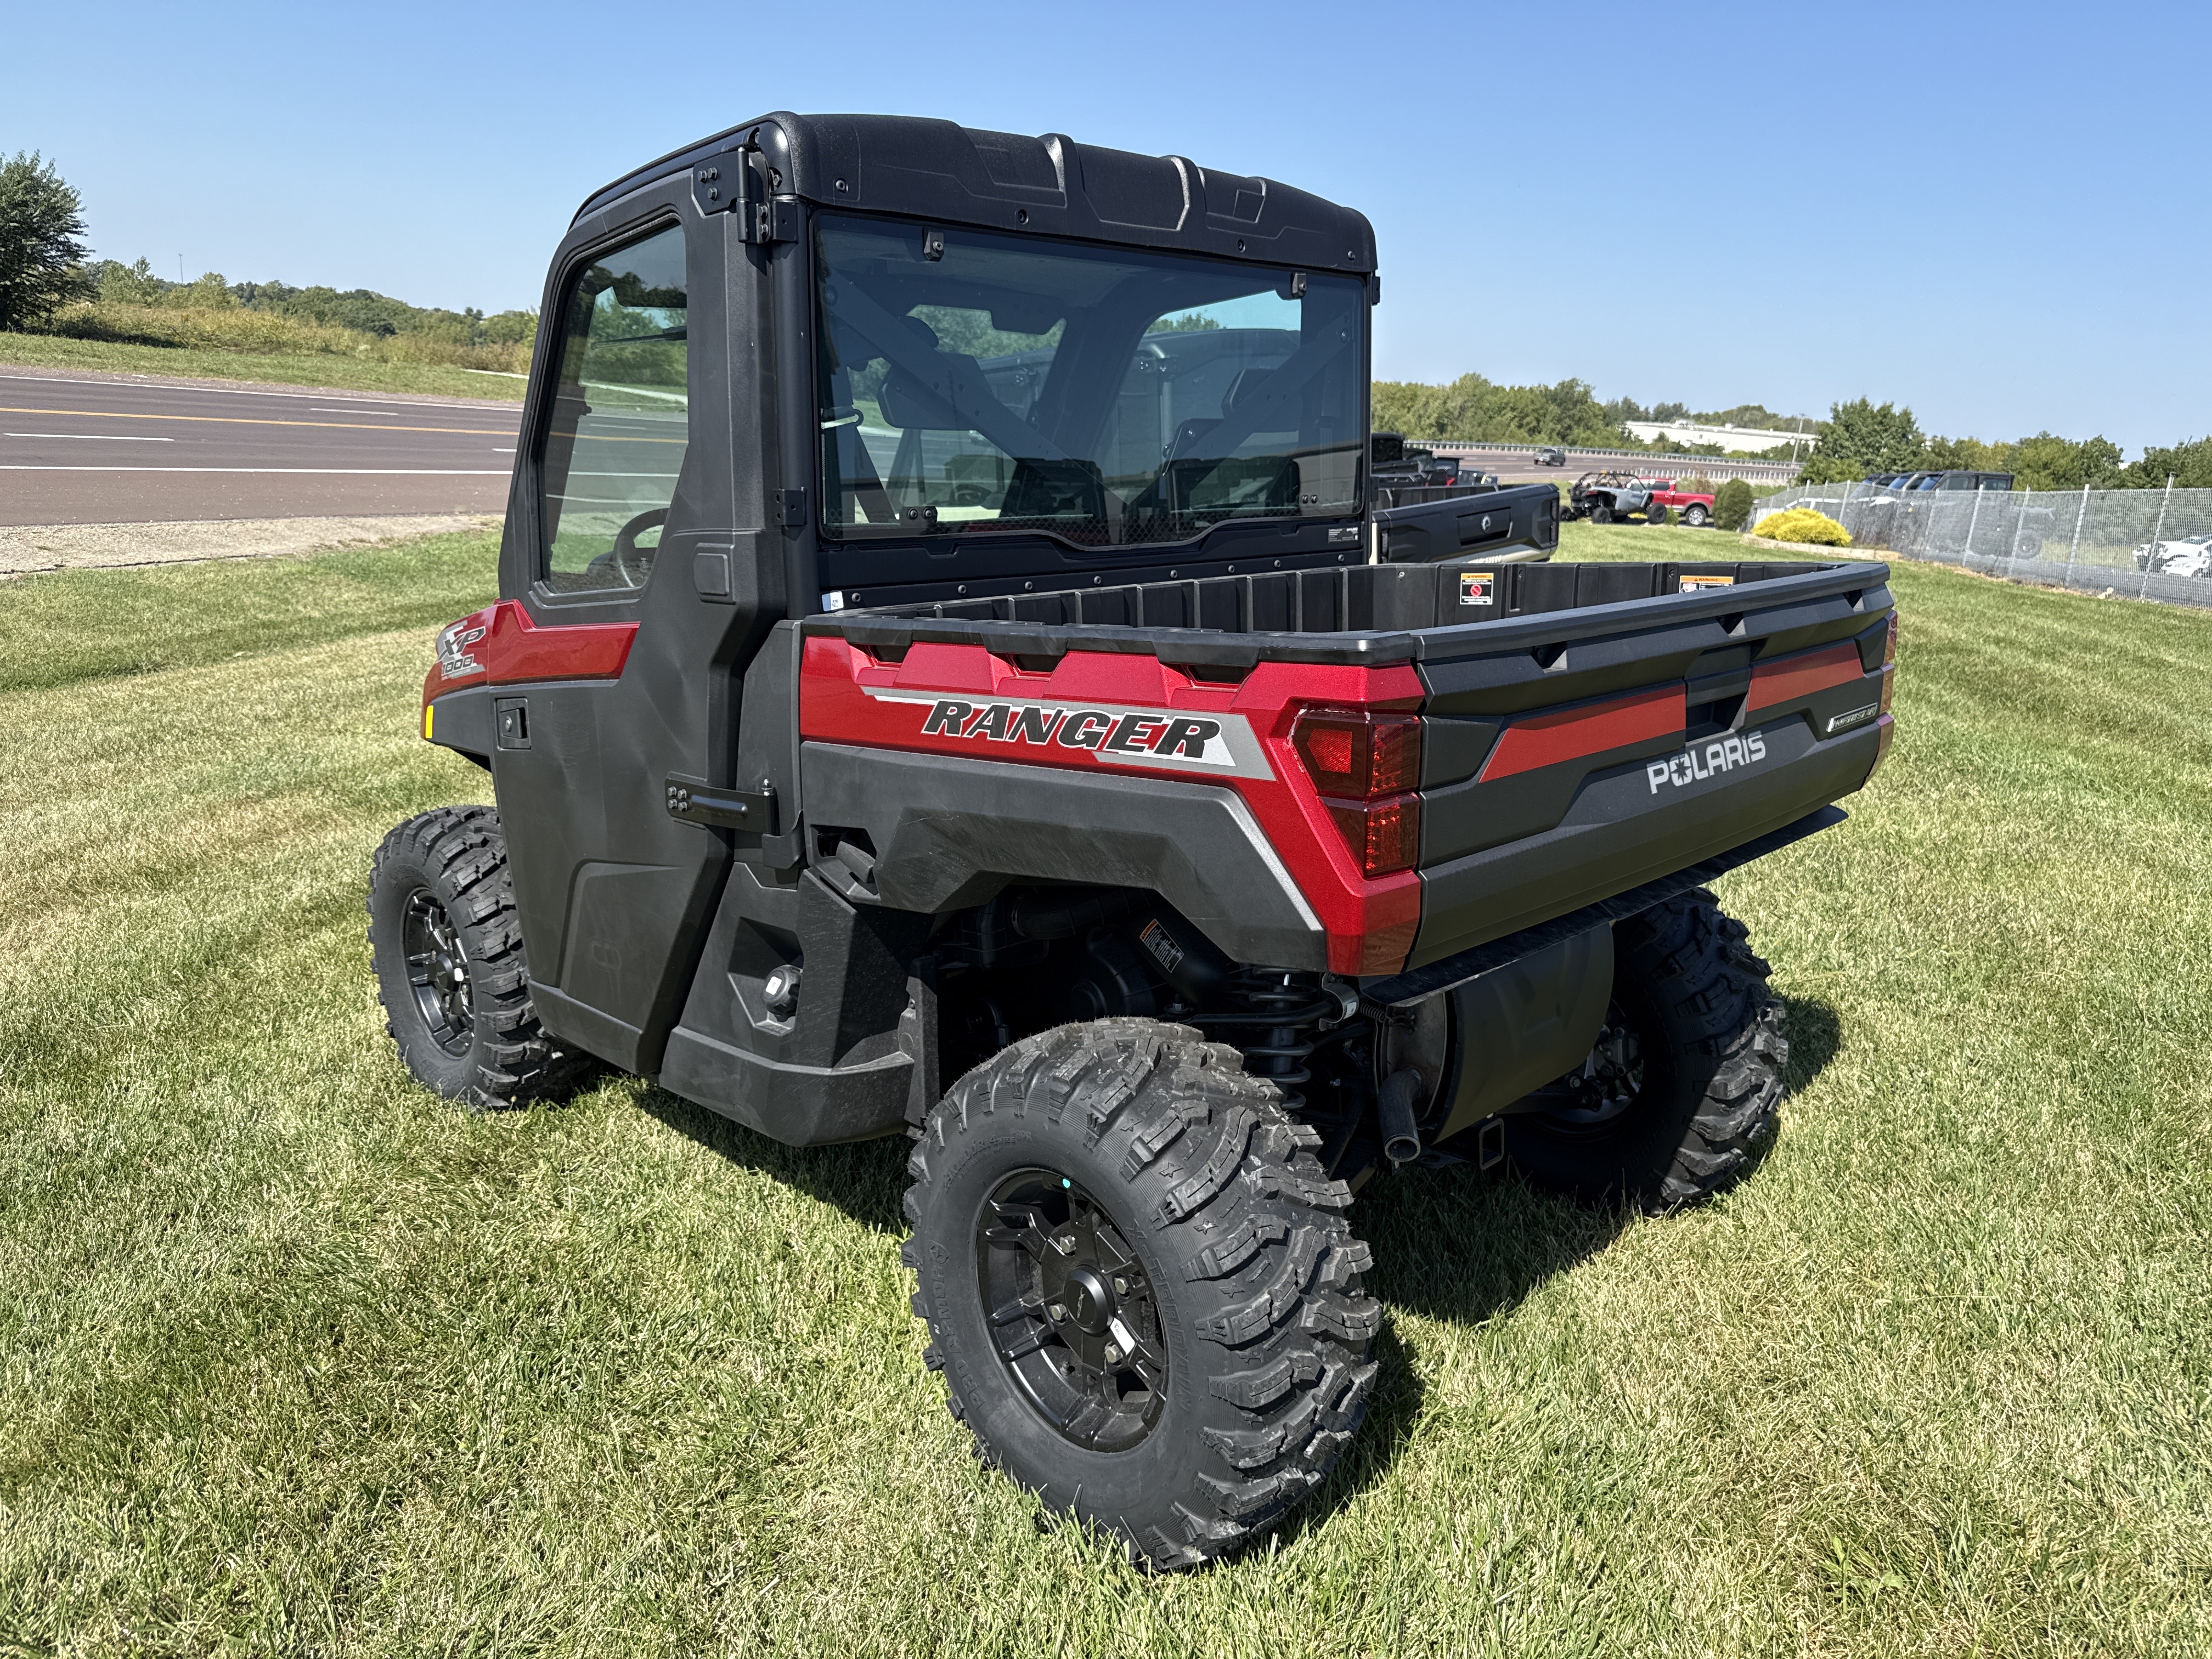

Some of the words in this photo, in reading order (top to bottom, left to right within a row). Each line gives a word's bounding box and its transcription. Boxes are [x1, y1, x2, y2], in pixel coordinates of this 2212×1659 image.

[438, 626, 486, 661] XP
[441, 654, 474, 676] 1000
[922, 700, 1220, 758] RANGER
[1646, 730, 1767, 794] POLARIS
[930, 1265, 962, 1355] ARMOR
[955, 1358, 985, 1410] PRO
